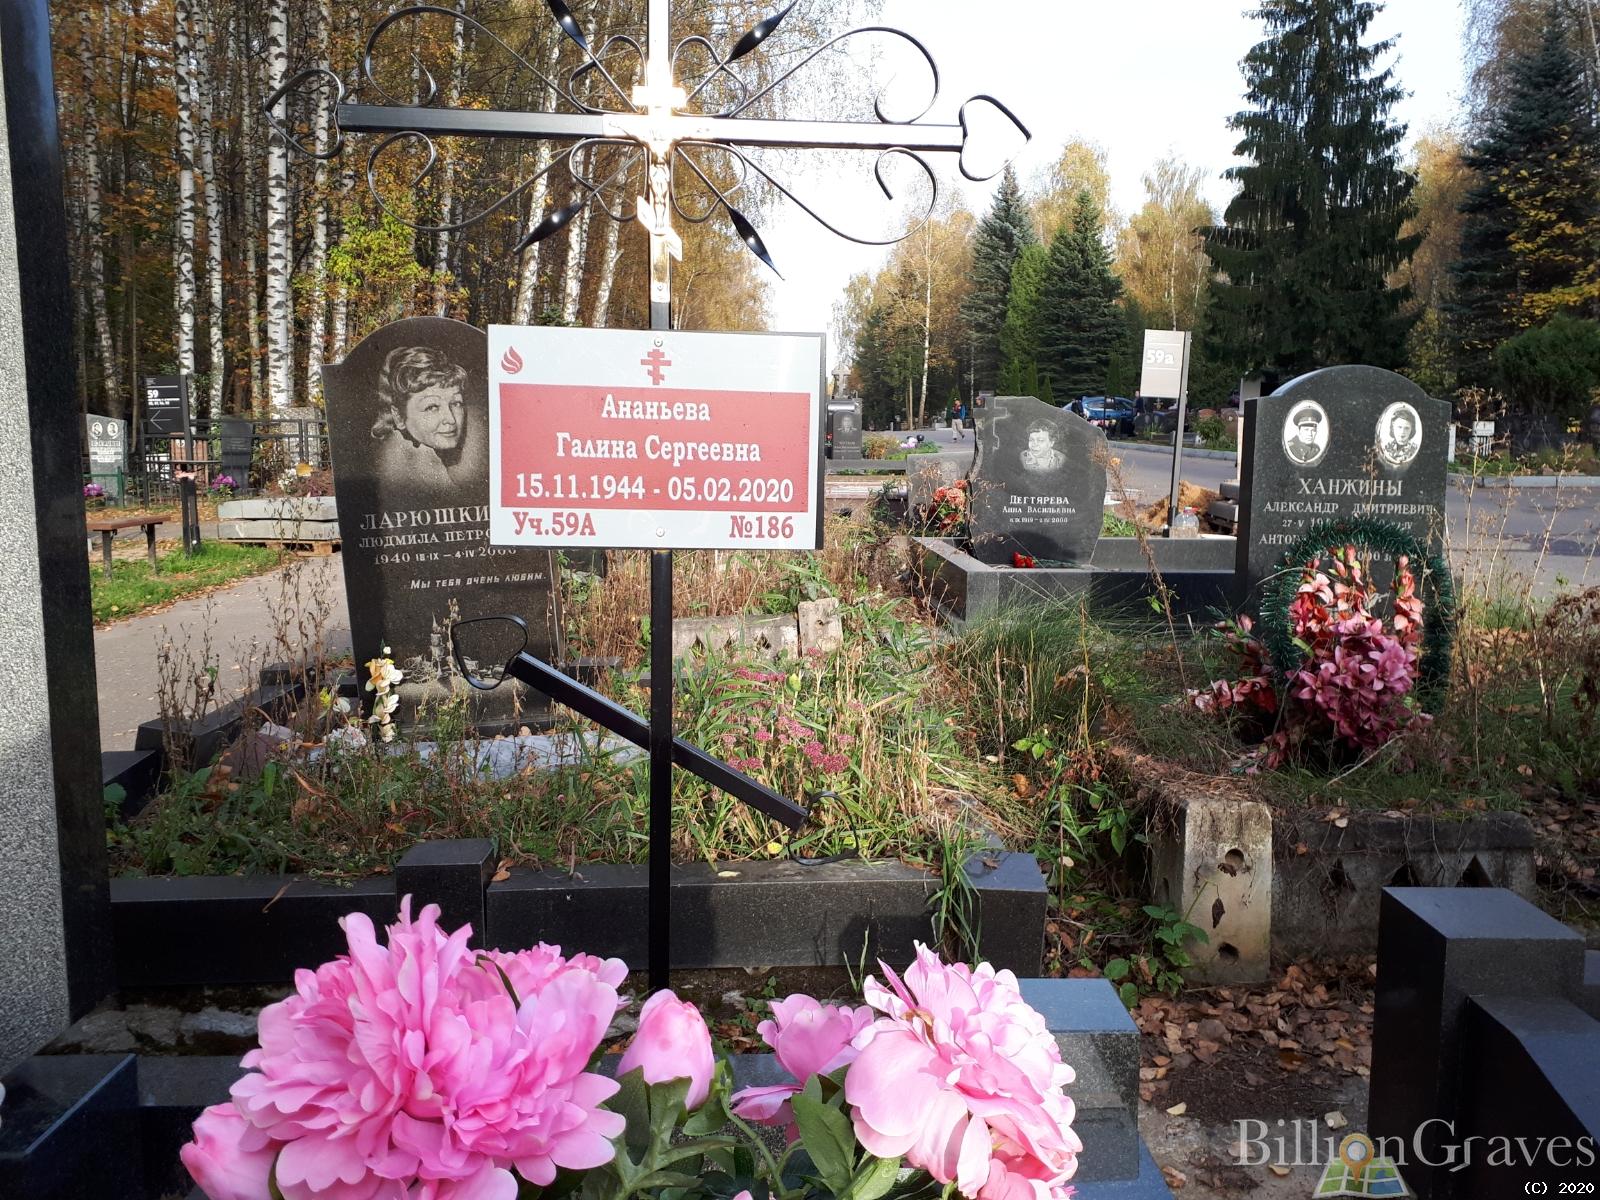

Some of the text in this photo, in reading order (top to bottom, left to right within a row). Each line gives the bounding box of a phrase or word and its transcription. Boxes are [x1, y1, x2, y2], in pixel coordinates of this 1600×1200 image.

[1146, 349, 1174, 365] 59а
[147, 389, 159, 399] 59
[600, 393, 711, 422] Ананьева
[556, 431, 761, 467] Галина Сергеевна
[516, 472, 645, 500] 15.11.1944
[667, 475, 794, 503] 05.02.2020
[1297, 478, 1403, 497] ХАНЖИНЫ
[1009, 495, 1070, 505] ДЕГТЯРЕВА
[1002, 505, 1076, 514] АННА ВАСИЛЬЕВНА
[1263, 501, 1434, 518] АЛЕКСАНДР ДМИТРИЕВИЧ
[512, 511, 794, 539] Уч.59А №186
[359, 531, 439, 549] ЛЮДМИЛА
[375, 552, 411, 565] 1940
[467, 576, 500, 585] ОЧЕНЬ
